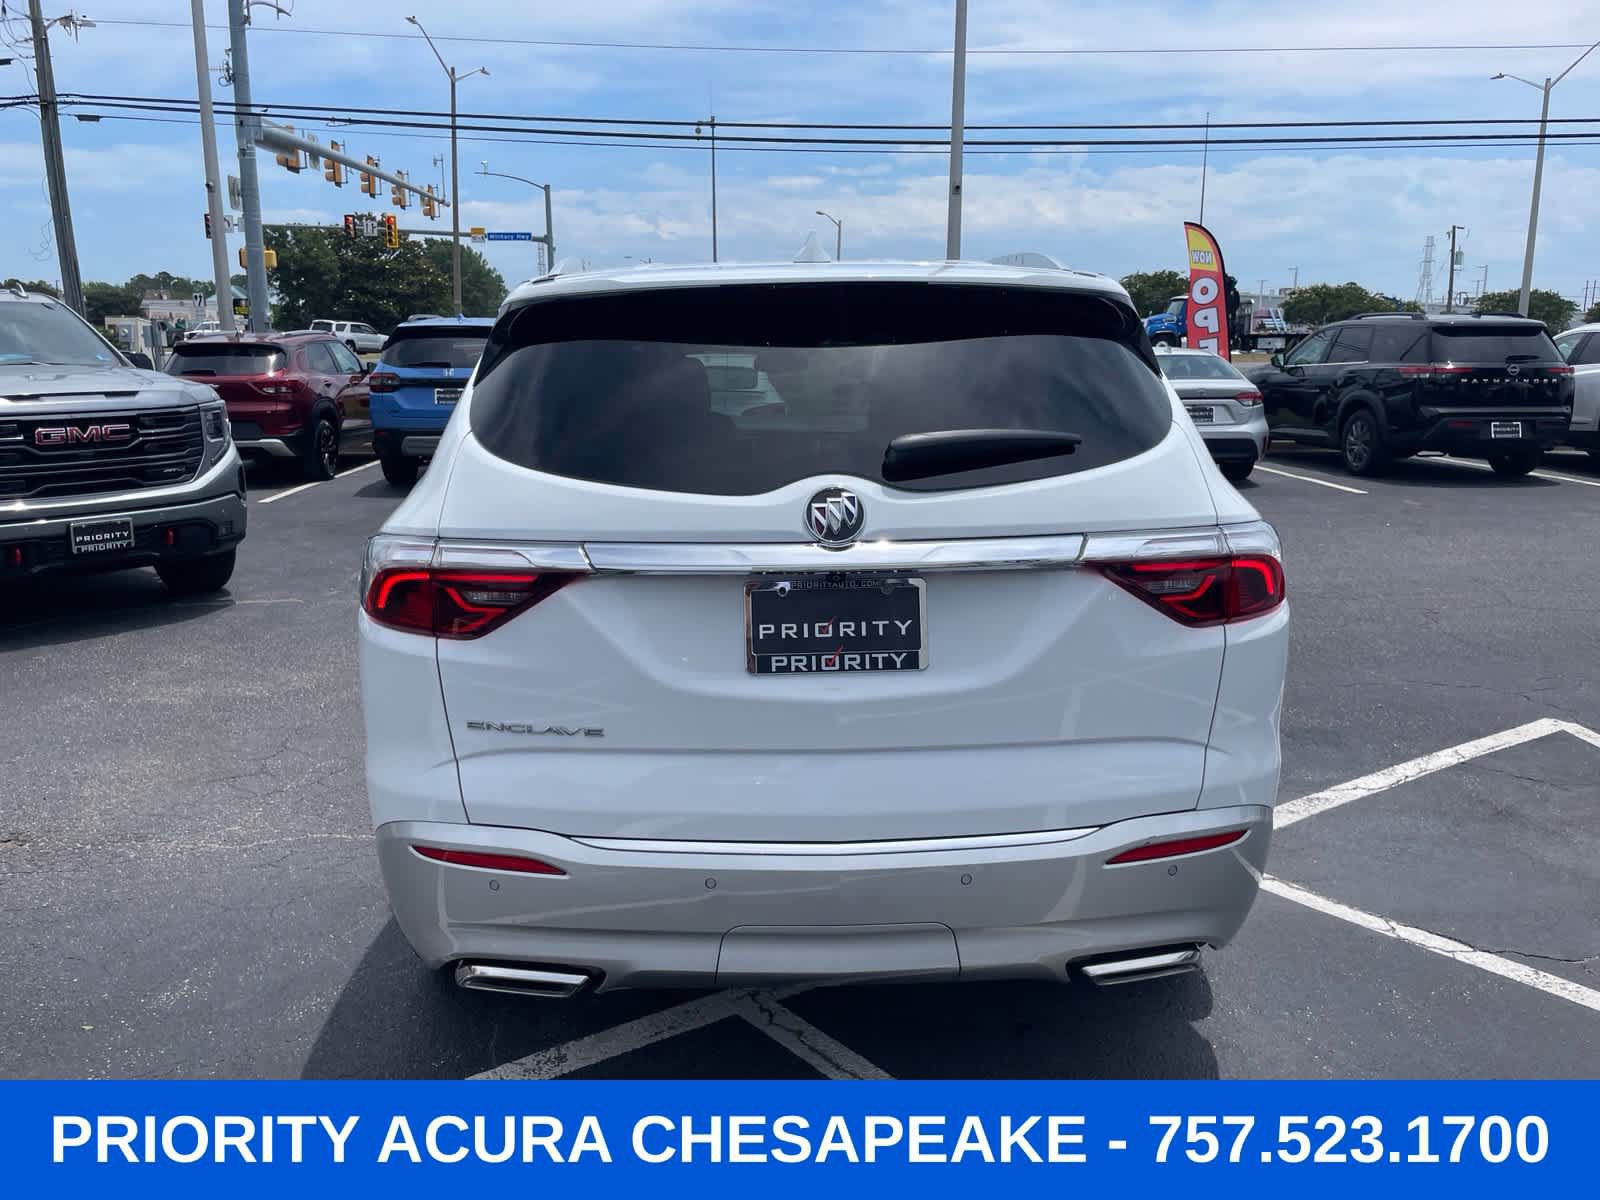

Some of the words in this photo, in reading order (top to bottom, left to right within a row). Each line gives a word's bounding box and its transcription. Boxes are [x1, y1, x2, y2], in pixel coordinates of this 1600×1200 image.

[35, 424, 130, 445] GMC
[76, 530, 129, 543] PRIORITY
[82, 542, 128, 553] PRIORITY
[758, 619, 913, 640] PRIORITY
[770, 652, 908, 673] PRIORITY
[466, 721, 605, 737] ENCLAVE
